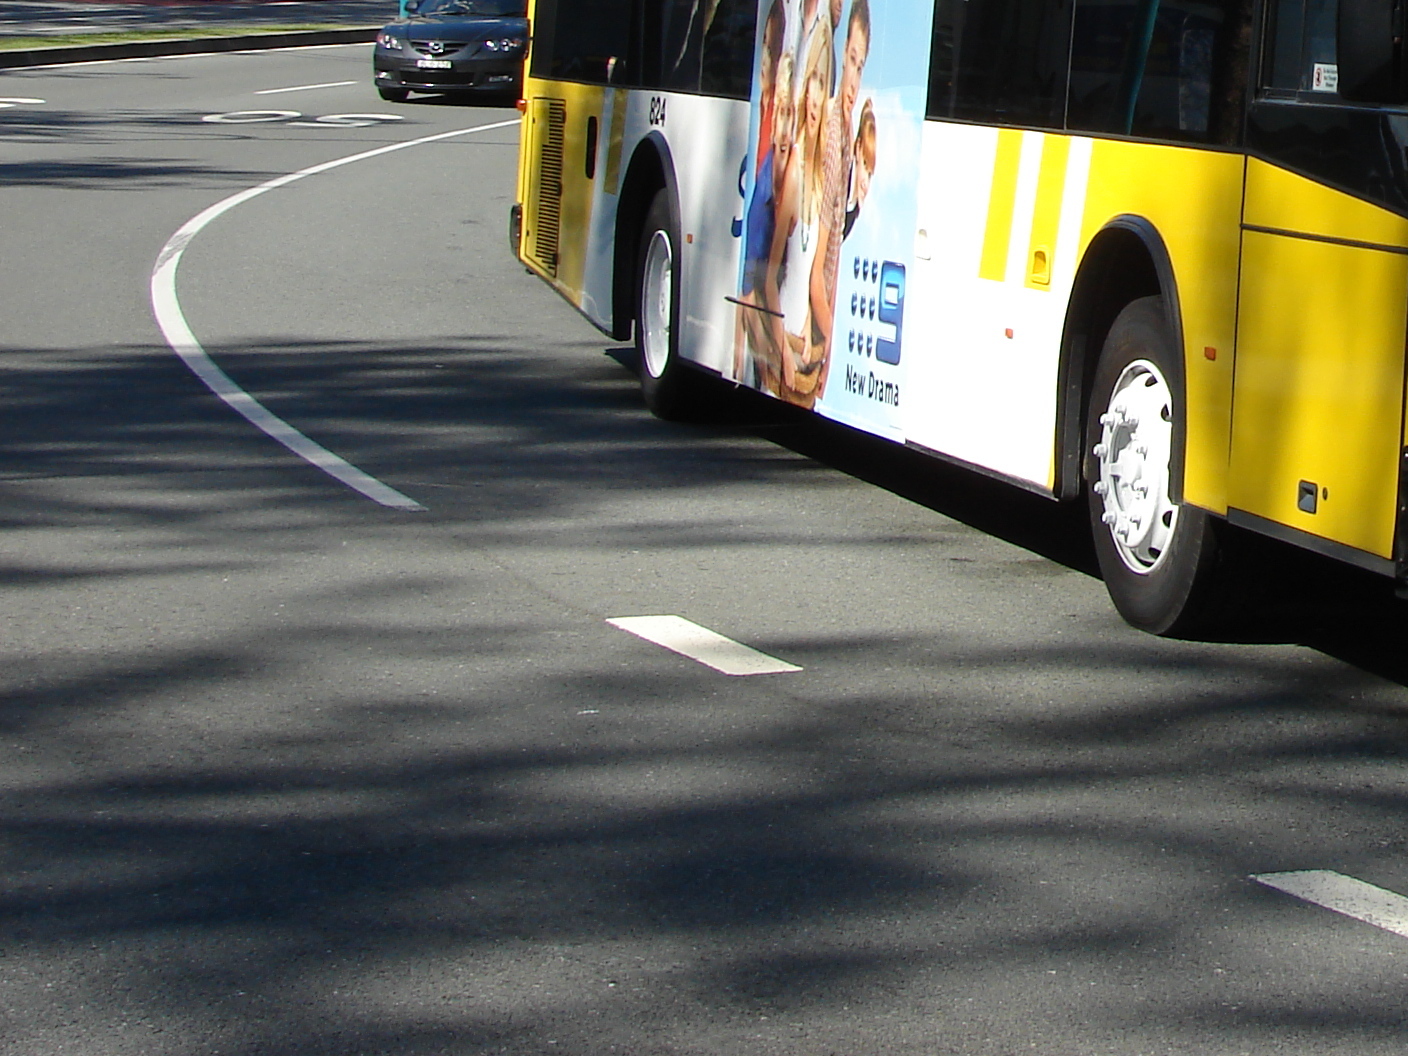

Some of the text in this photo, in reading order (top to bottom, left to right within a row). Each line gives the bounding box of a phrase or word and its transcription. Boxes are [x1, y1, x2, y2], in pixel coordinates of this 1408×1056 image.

[649, 96, 667, 127] 824
[845, 364, 900, 408] New Drama
